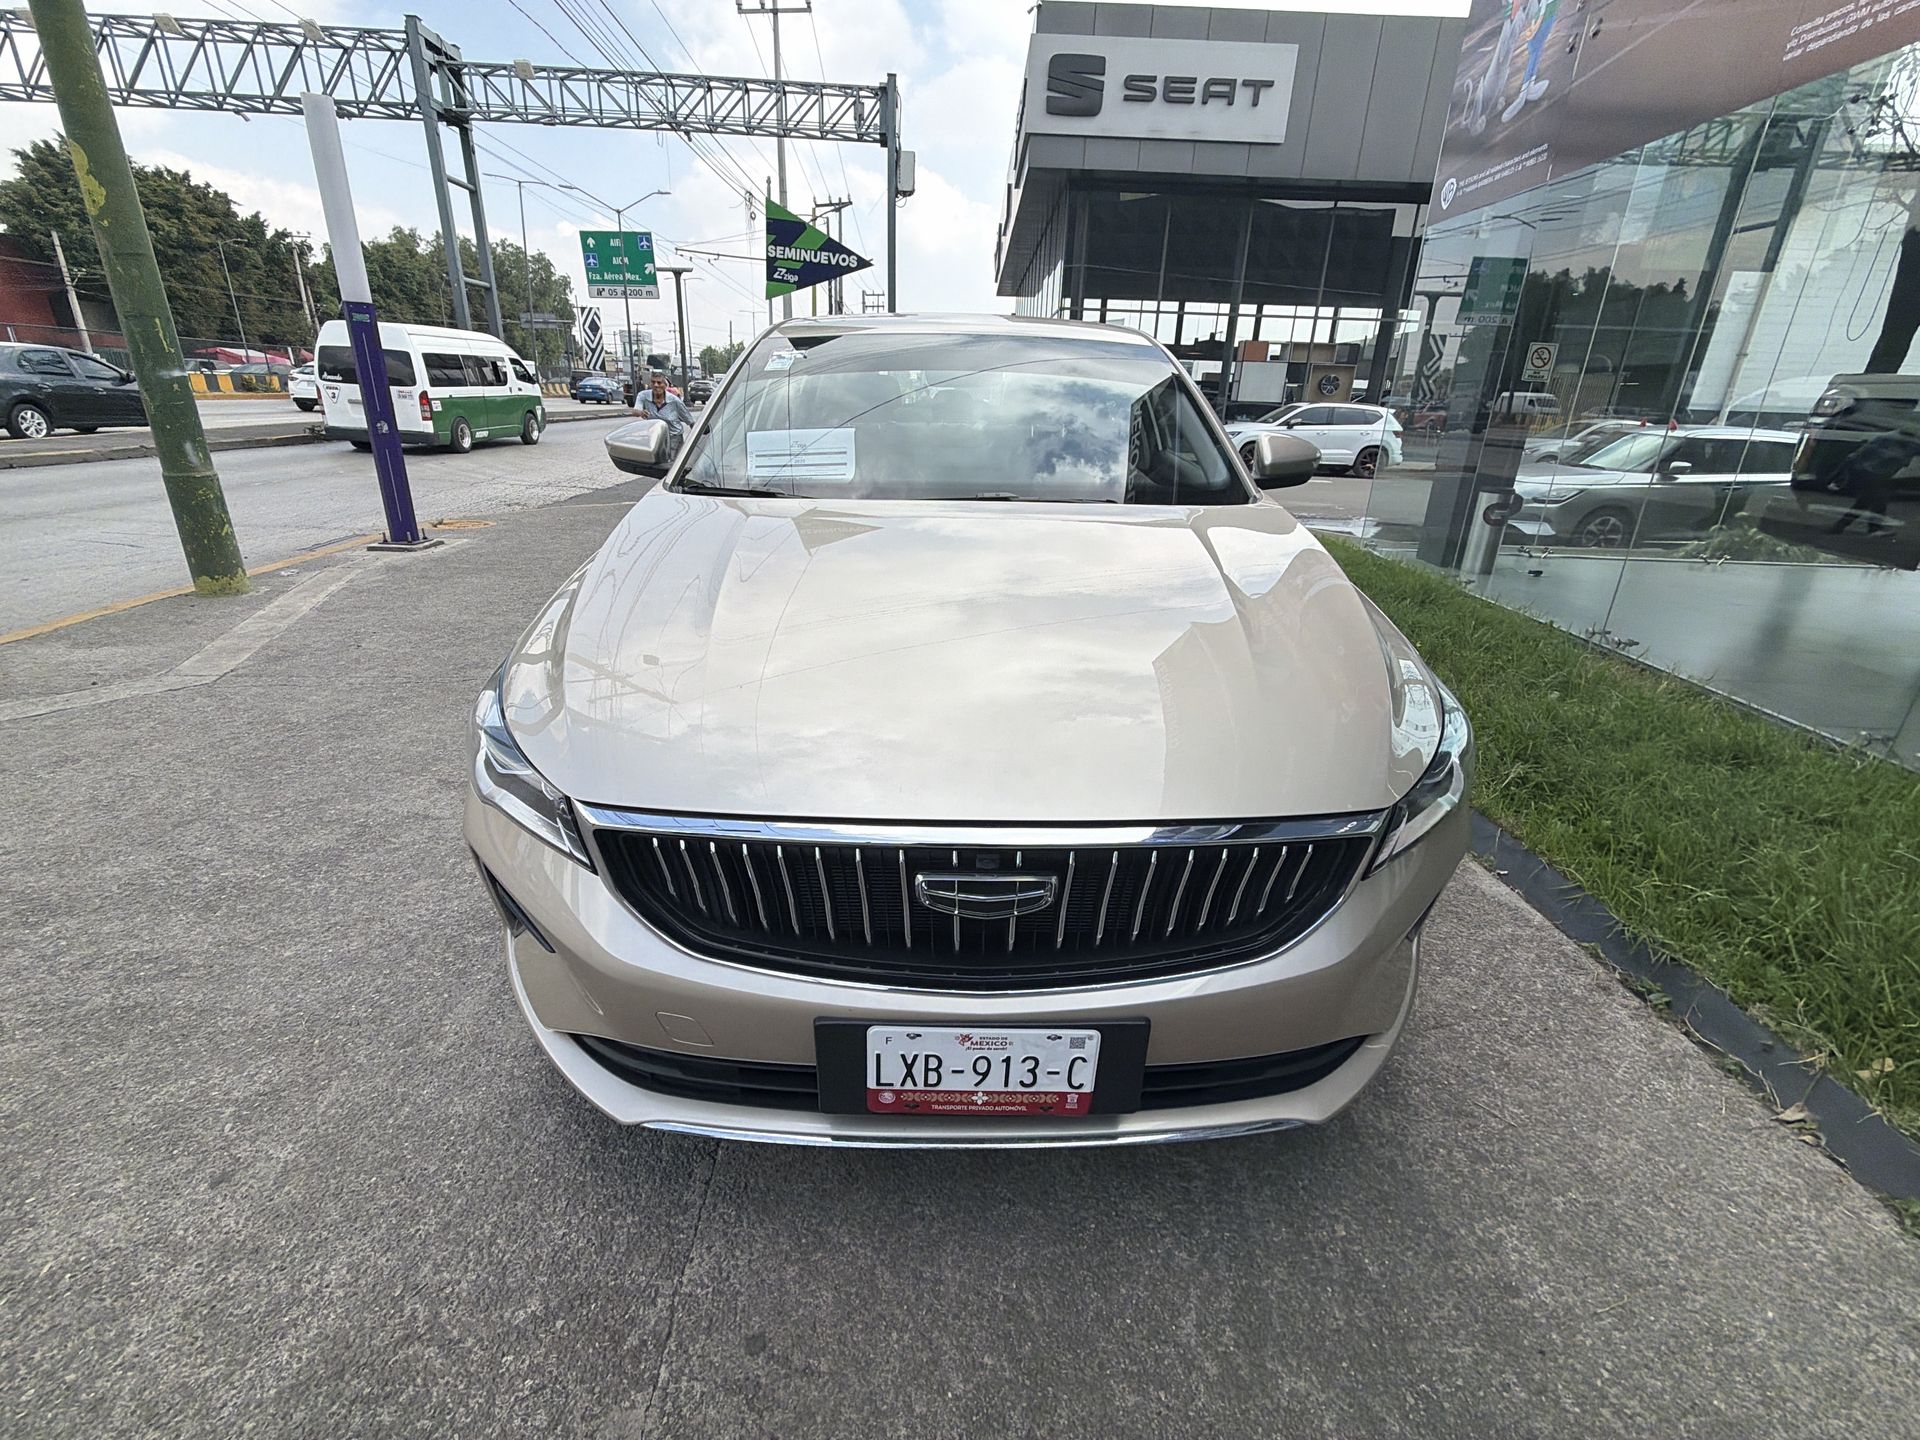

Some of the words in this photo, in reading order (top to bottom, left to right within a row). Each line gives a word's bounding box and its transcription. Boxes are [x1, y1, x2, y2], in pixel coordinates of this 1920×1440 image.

[1123, 75, 1275, 107] SEAT
[767, 244, 858, 268] SEMINUEVOS
[588, 272, 603, 280] Fza.
[604, 272, 624, 281] Aérea
[625, 273, 642, 281] Mex.
[608, 288, 618, 297] 05
[628, 288, 643, 297] 200
[885, 1036, 892, 1045] F
[874, 1052, 1088, 1090] LXB-913-C
